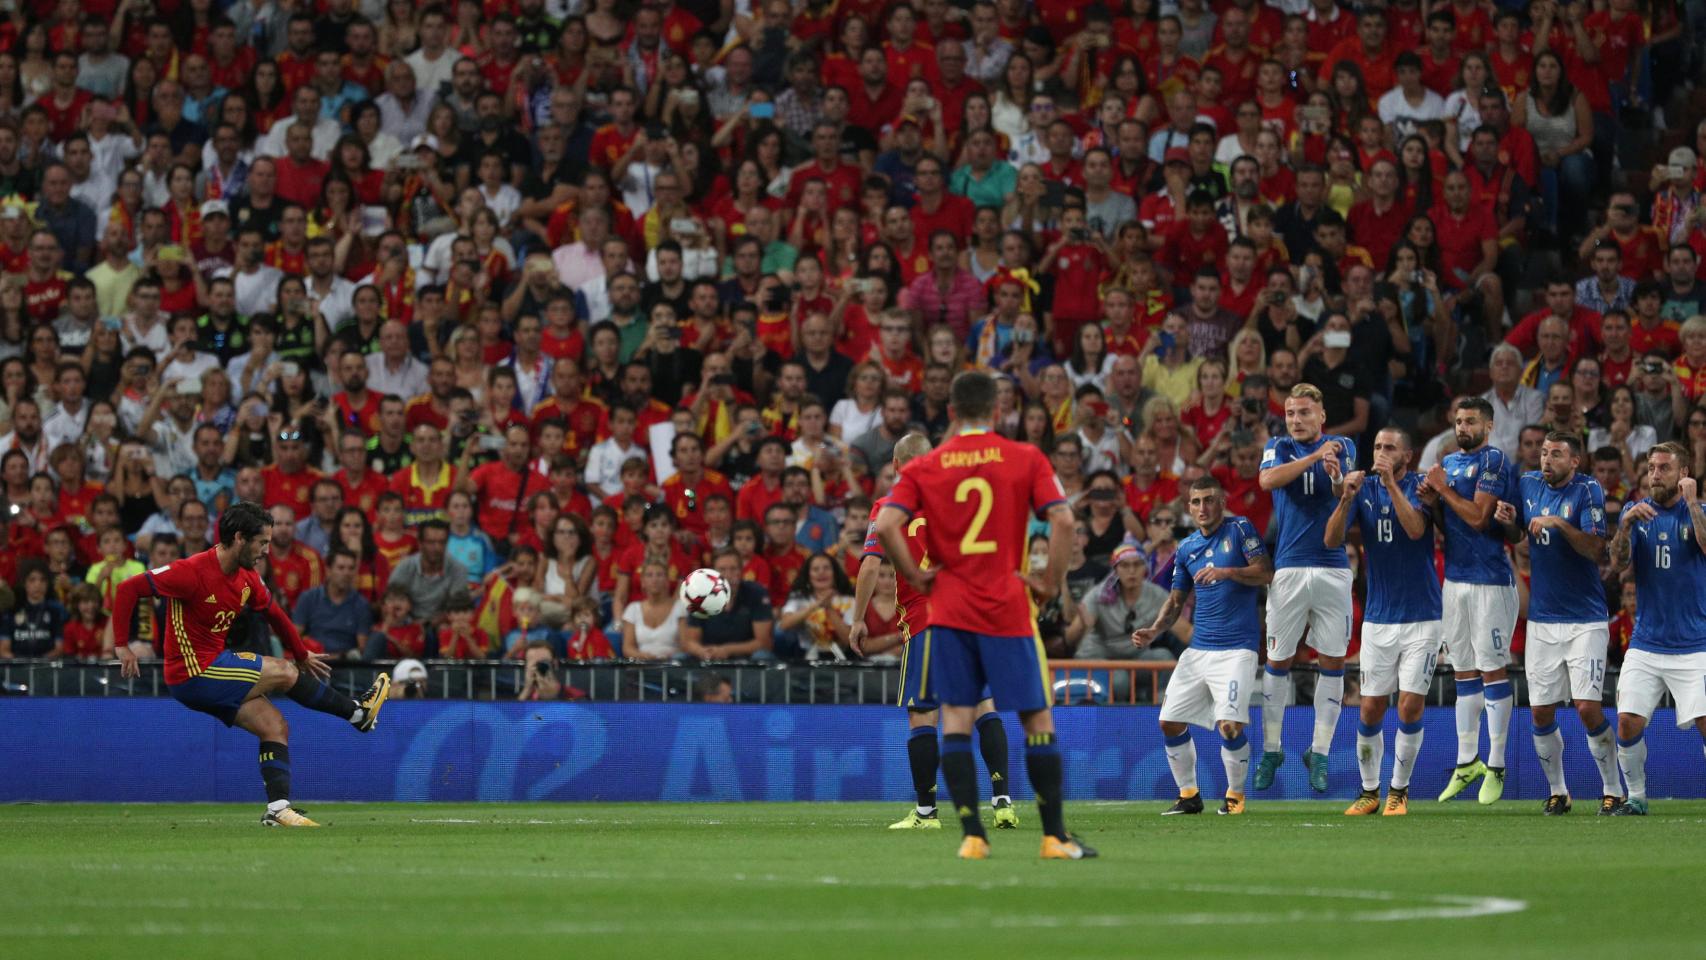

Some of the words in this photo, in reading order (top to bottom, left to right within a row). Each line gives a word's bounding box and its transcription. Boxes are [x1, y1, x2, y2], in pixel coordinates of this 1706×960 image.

[940, 447, 1004, 469] CARVAJAL
[1303, 471, 1314, 495] 11
[955, 476, 998, 554] 2
[1377, 519, 1393, 543] 19
[1655, 545, 1671, 569] 16
[1491, 627, 1502, 650] 6
[1423, 651, 1437, 677] 19
[1590, 658, 1603, 682] 15
[1228, 679, 1239, 702] 8
[660, 708, 869, 801] Air
